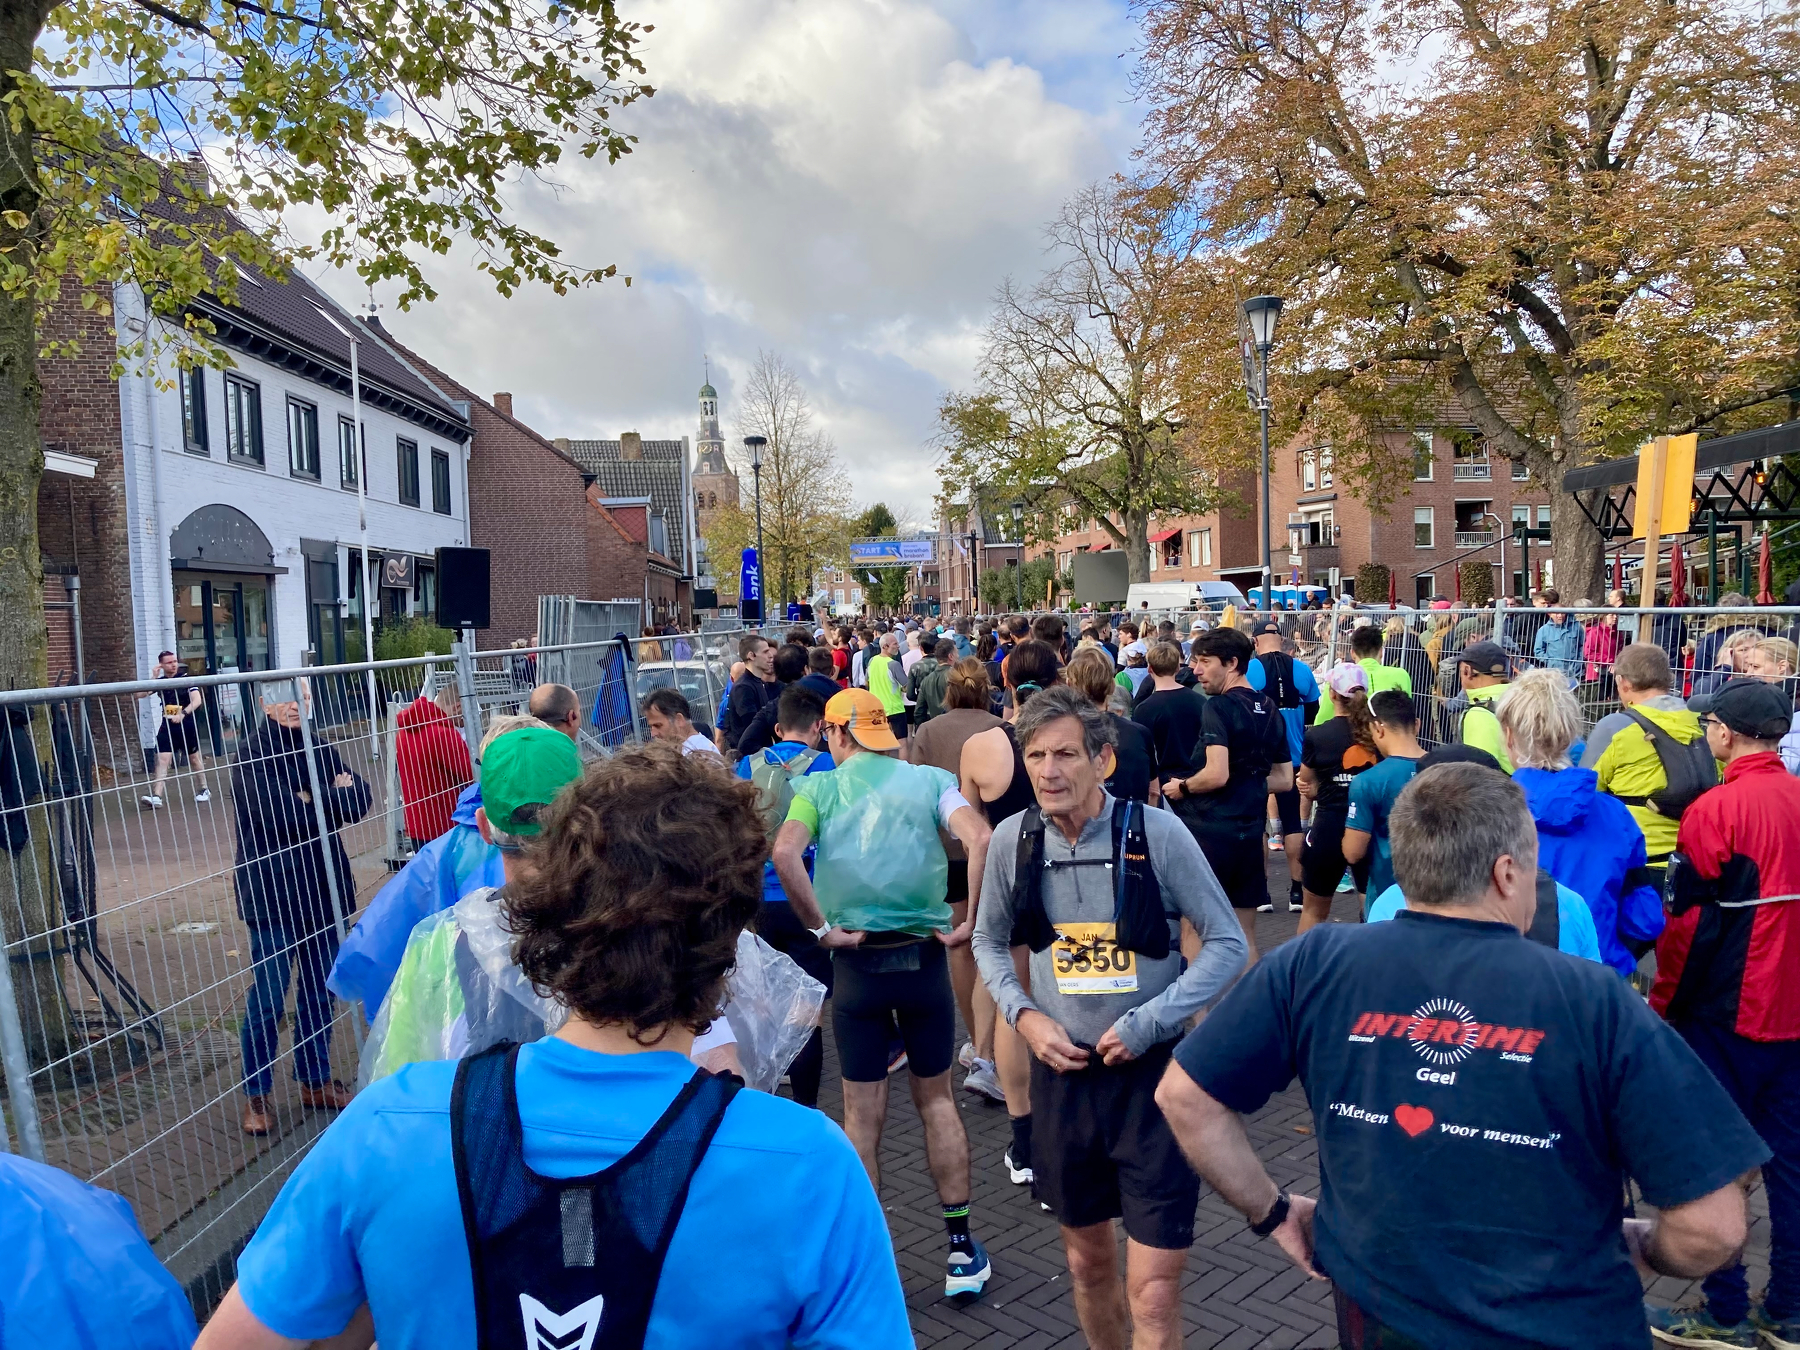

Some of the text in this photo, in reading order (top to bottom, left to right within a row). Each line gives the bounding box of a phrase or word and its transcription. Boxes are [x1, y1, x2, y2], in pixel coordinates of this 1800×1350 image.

[1081, 933, 1098, 942] JAN
[1351, 1011, 1546, 1055] INTERTIME
[1500, 1051, 1533, 1064] Selectie
[1416, 1067, 1456, 1086] Geel
[1440, 1121, 1480, 1139] voor
